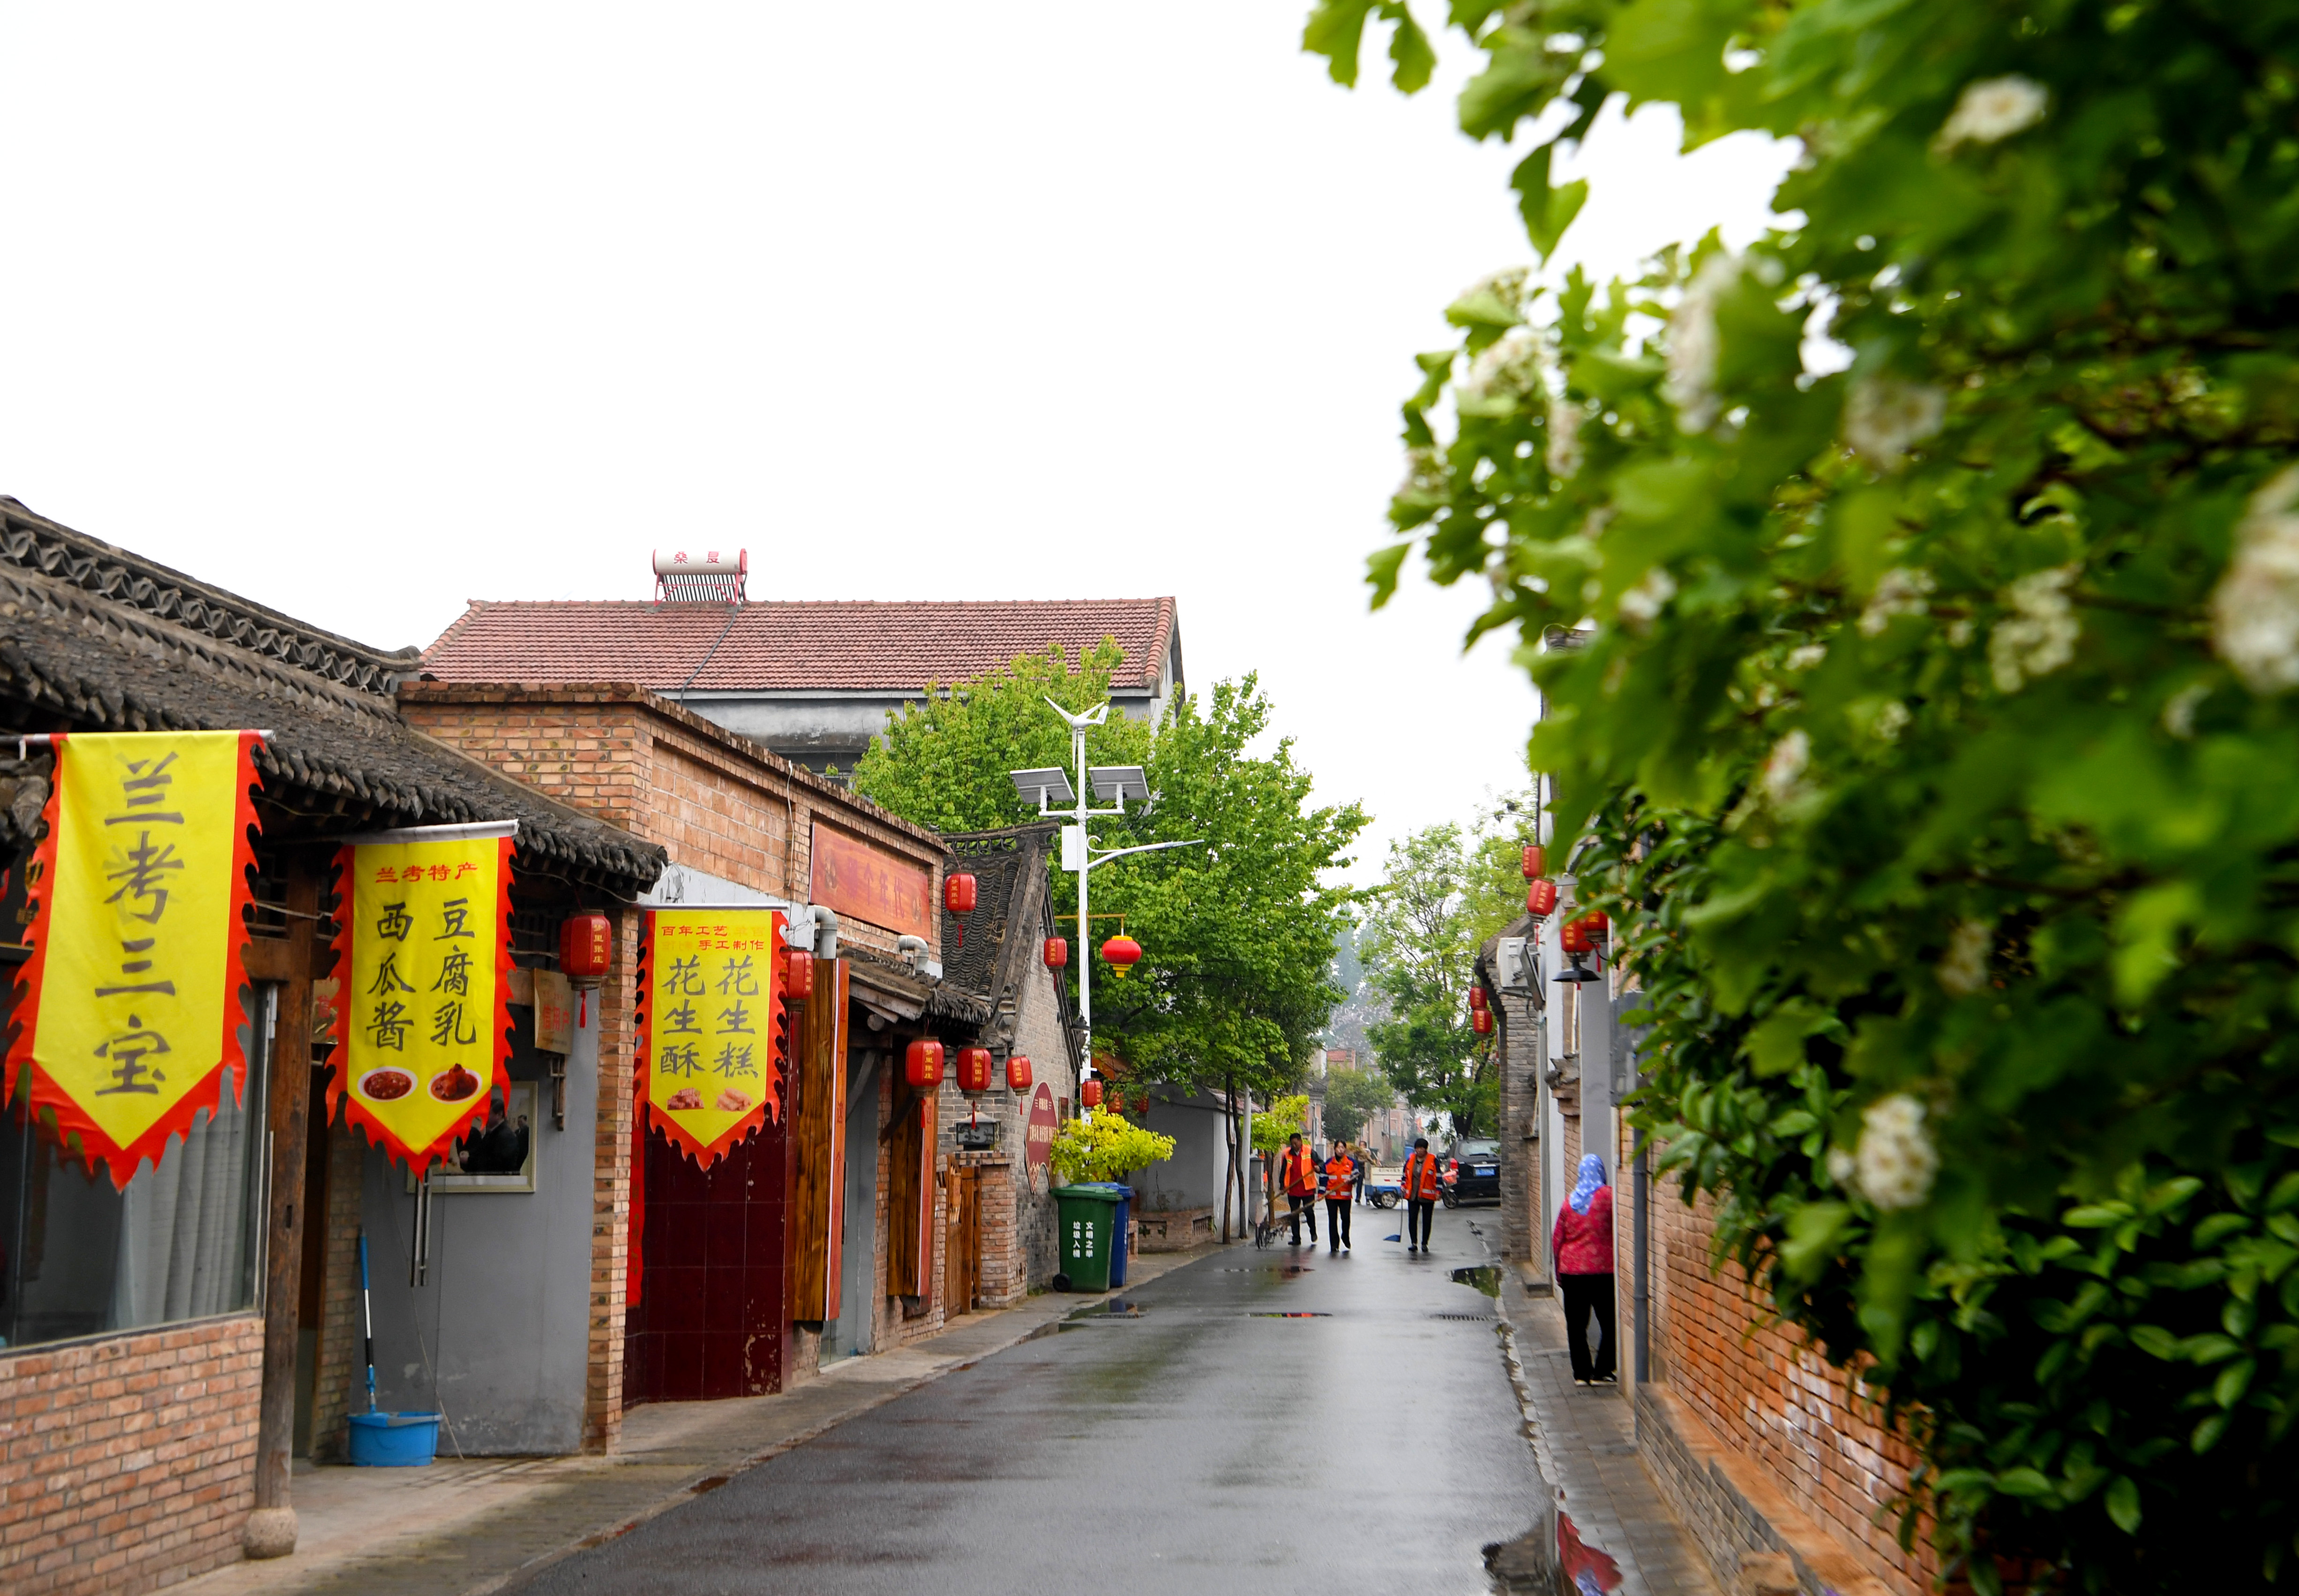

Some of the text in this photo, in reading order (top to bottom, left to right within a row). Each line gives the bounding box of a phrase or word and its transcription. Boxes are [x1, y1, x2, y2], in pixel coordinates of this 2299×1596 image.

[375, 862, 478, 884] 兰考特产
[94, 751, 185, 1096] 兰考三宝
[661, 925, 728, 937] 百年工艺
[593, 924, 604, 963] 梦里张庄
[699, 940, 764, 951] 手工制作
[366, 901, 416, 1052] 西瓜酱
[429, 898, 476, 1046] 豆腐乳
[660, 954, 706, 1079] 花生酥
[712, 954, 759, 1079] 花生糕
[924, 1049, 934, 1079] 梦里张庄
[1072, 1221, 1081, 1258] 垃圾入桶
[1085, 1221, 1094, 1258] 文明之举
